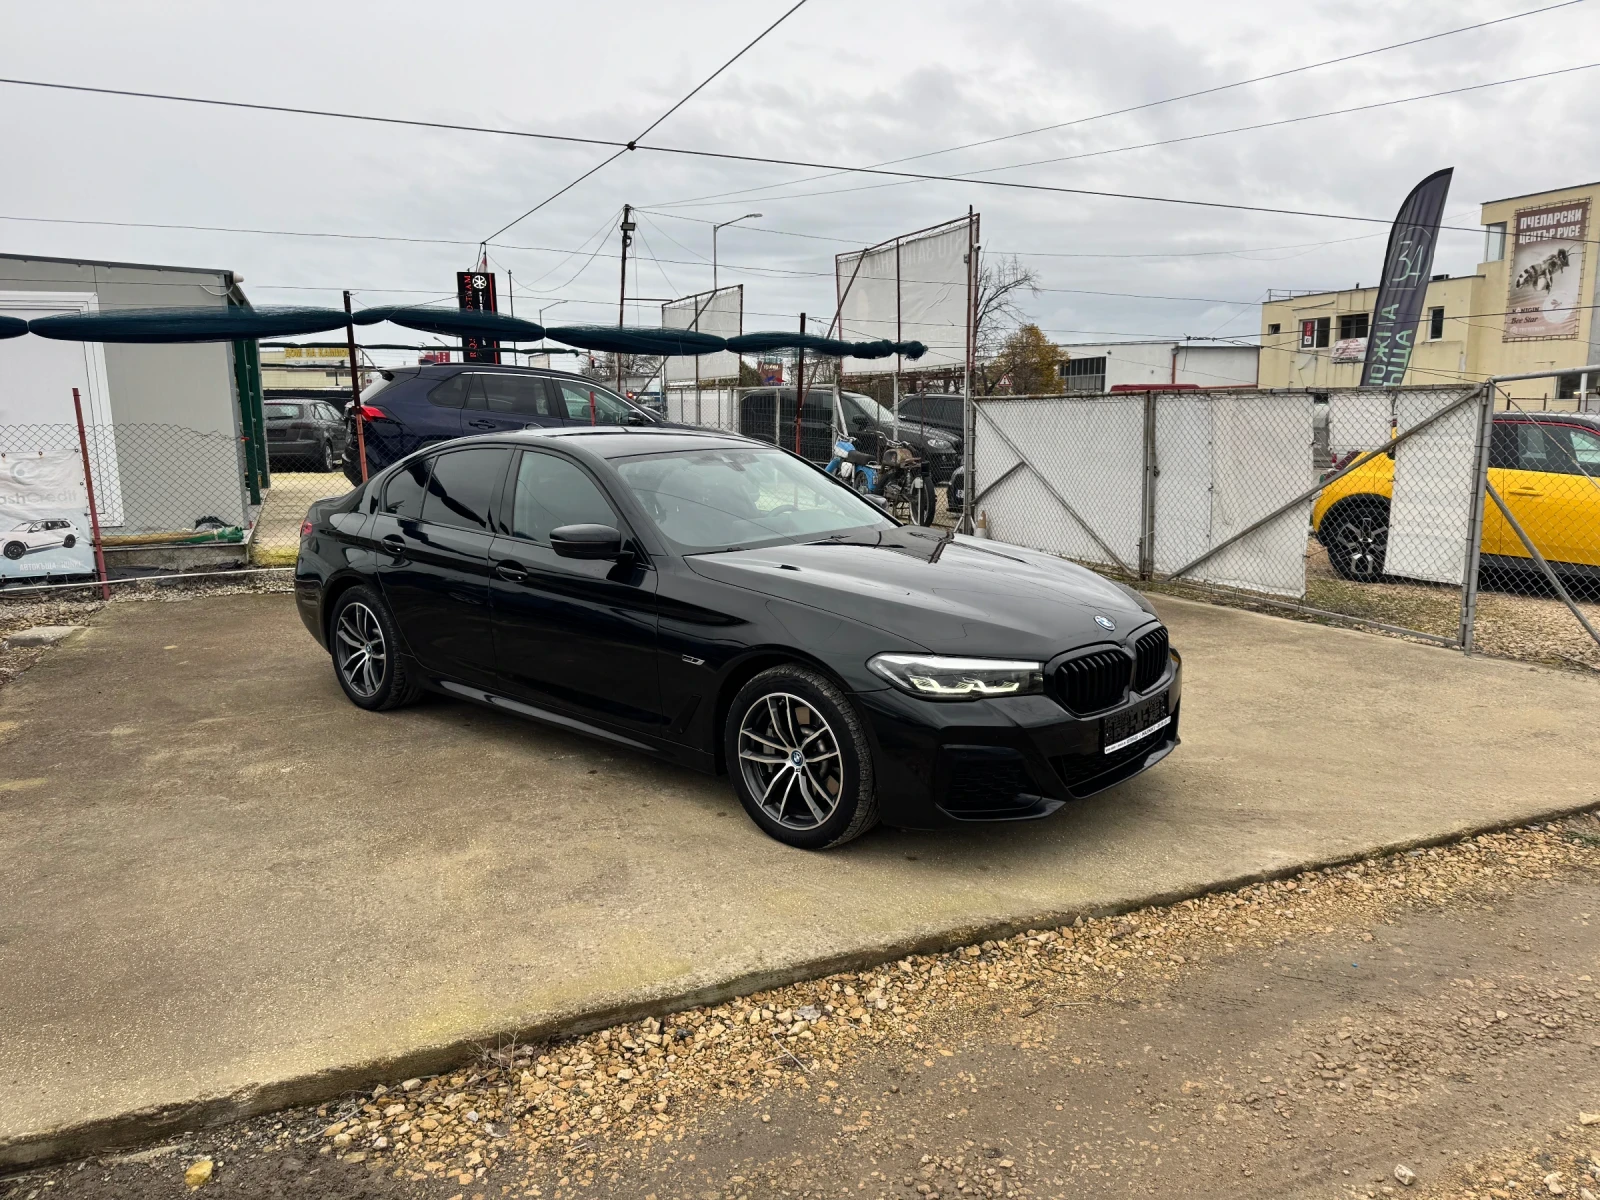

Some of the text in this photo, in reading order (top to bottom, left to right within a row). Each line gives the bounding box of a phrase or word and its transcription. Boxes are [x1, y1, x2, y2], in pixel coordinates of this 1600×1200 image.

[1520, 208, 1582, 230] ПЧЕЛАРСКИ
[1519, 224, 1581, 244] ЦЕНТЪР РУСЕ
